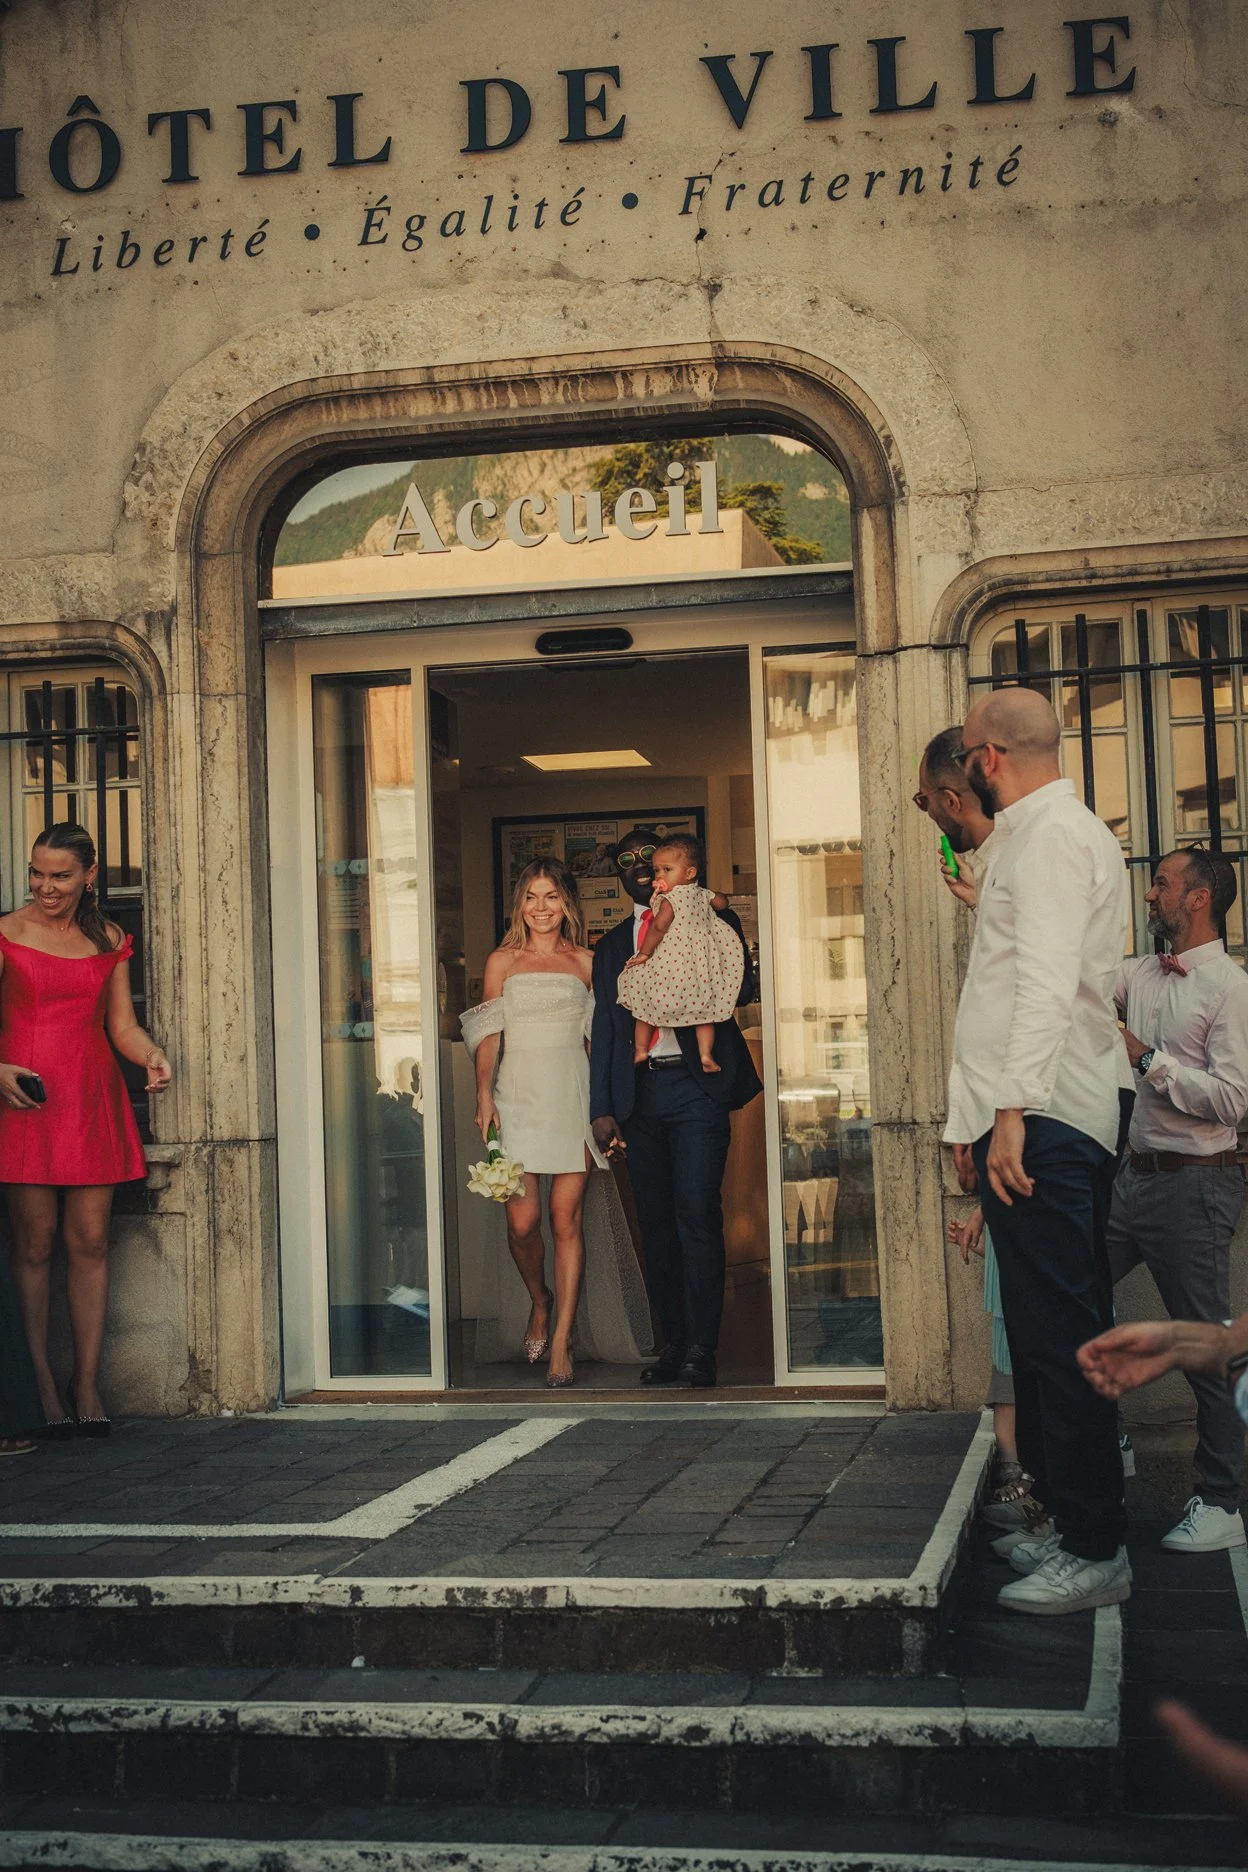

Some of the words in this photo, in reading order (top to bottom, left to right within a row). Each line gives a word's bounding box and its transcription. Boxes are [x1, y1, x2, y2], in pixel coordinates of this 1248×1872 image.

[458, 64, 627, 155] DE
[699, 15, 1137, 131] VILLE
[50, 218, 271, 277] Liberté
[357, 186, 587, 253] Égalité
[677, 144, 1024, 217] Fraternité
[382, 460, 725, 557] Accueil
